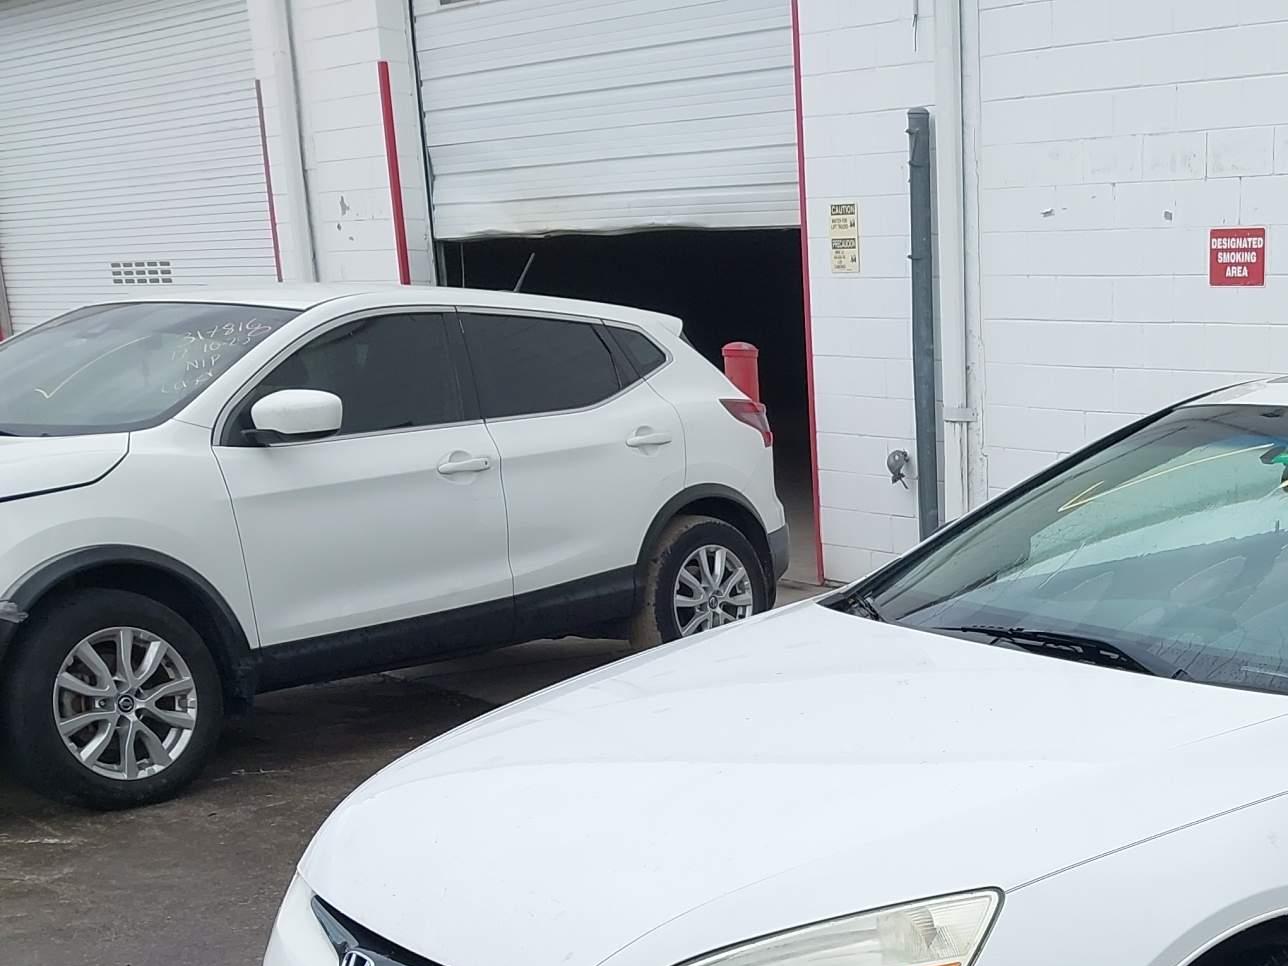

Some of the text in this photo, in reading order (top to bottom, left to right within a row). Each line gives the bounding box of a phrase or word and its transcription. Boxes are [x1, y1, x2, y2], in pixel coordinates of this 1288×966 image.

[832, 205, 855, 215] CAUTION
[1211, 237, 1264, 249] DESIGNATED
[1217, 251, 1257, 264] SMOKING
[1225, 266, 1249, 278] AREA
